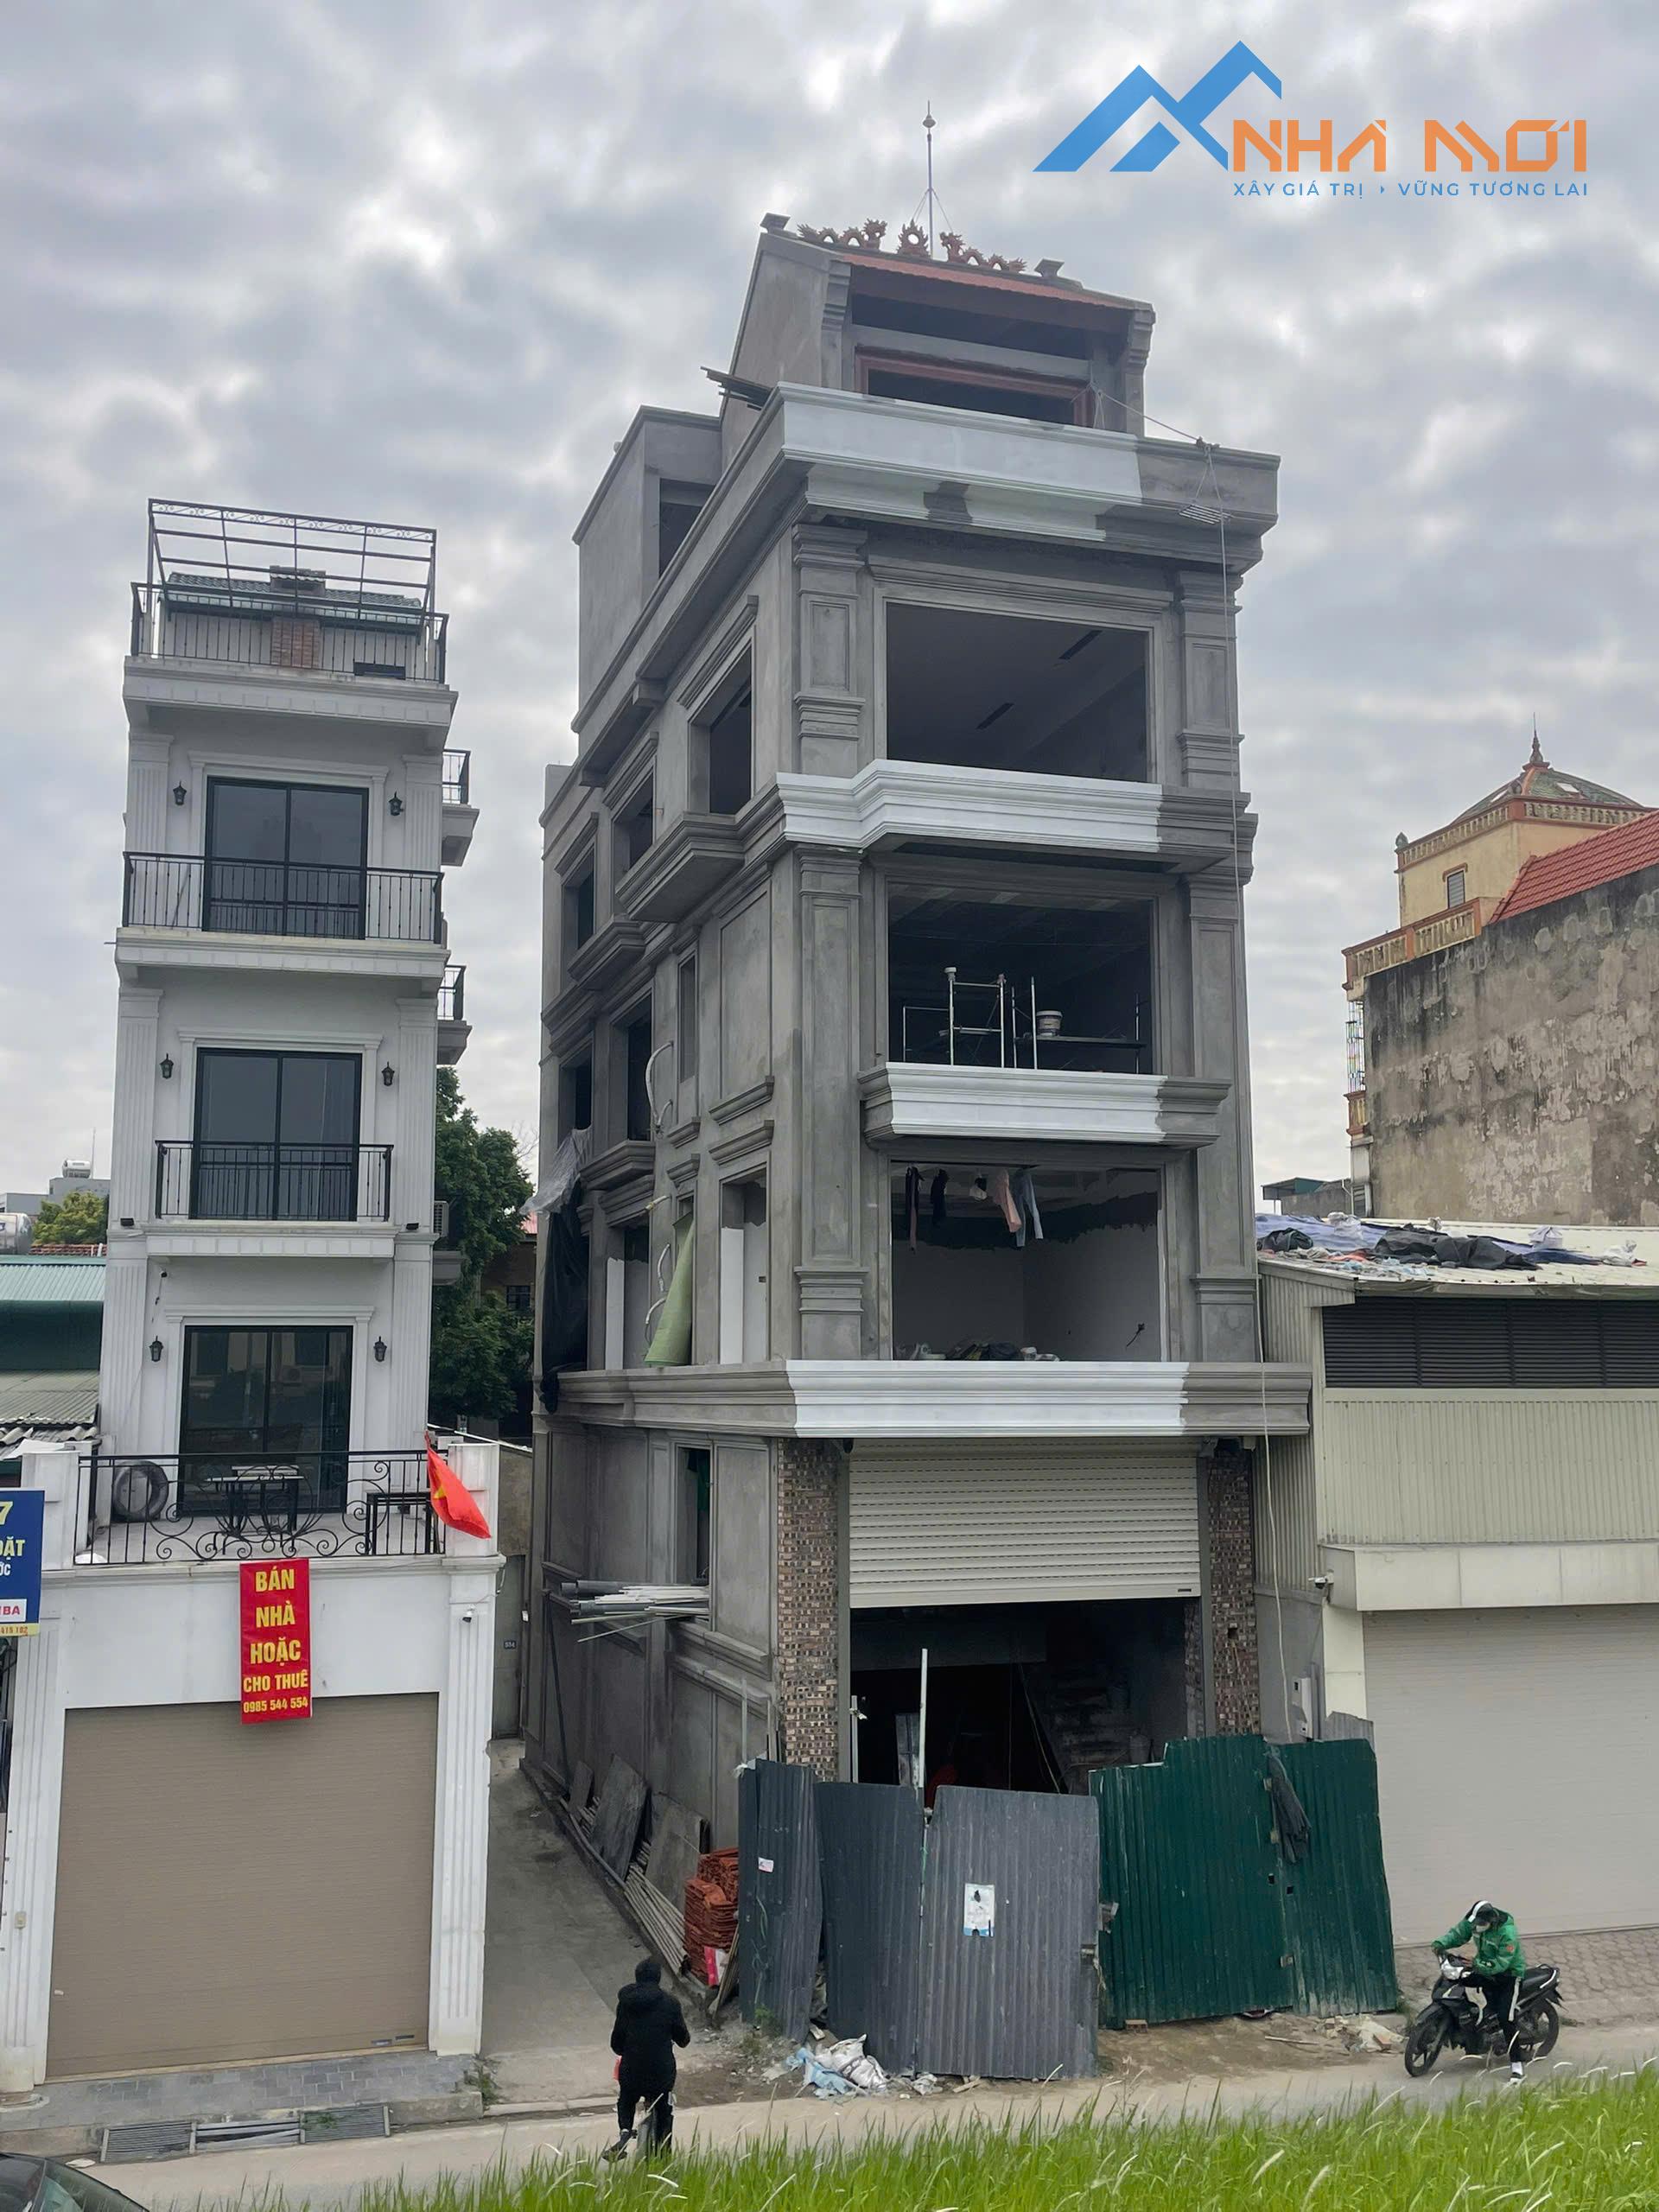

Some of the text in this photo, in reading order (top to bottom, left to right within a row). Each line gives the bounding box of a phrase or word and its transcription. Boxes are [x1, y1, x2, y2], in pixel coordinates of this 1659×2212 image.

[255, 1566, 295, 1592] BÁN
[0, 1605, 20, 1615] BA
[256, 1600, 296, 1628] NHÀ
[250, 1637, 302, 1666] HOẶC
[243, 1669, 308, 1693] CHO THUÊ
[243, 1695, 308, 1713] 0985 544 554
